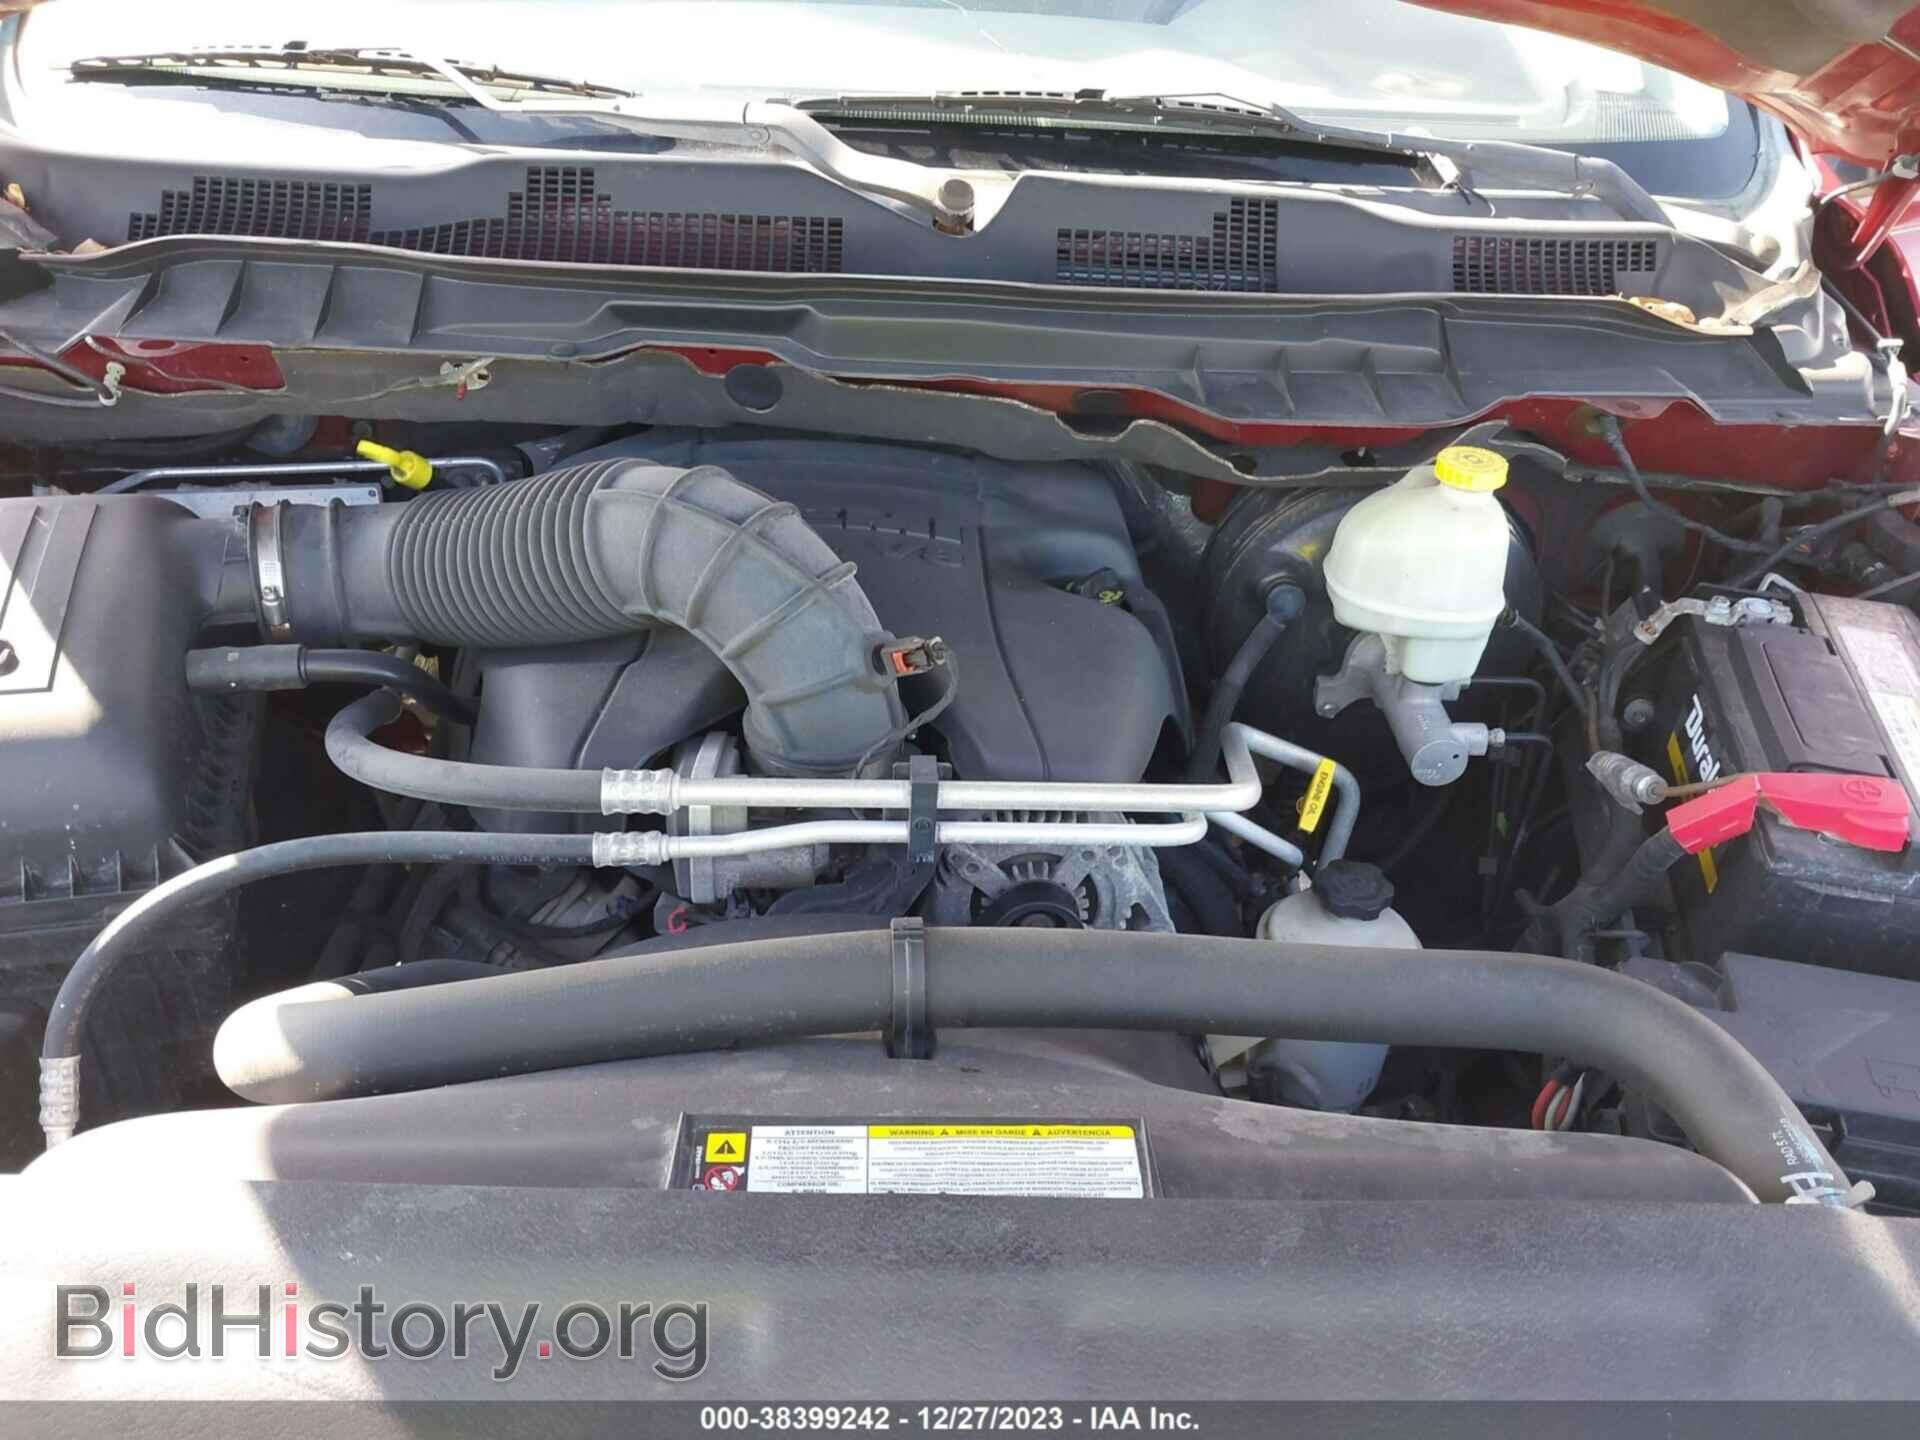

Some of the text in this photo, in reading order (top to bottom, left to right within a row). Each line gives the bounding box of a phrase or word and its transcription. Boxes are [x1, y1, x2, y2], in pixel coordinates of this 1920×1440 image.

[1684, 693, 1720, 783] Dural
[888, 1129, 935, 1137] WARNING
[1047, 1129, 1111, 1137] ADVERTENCIA
